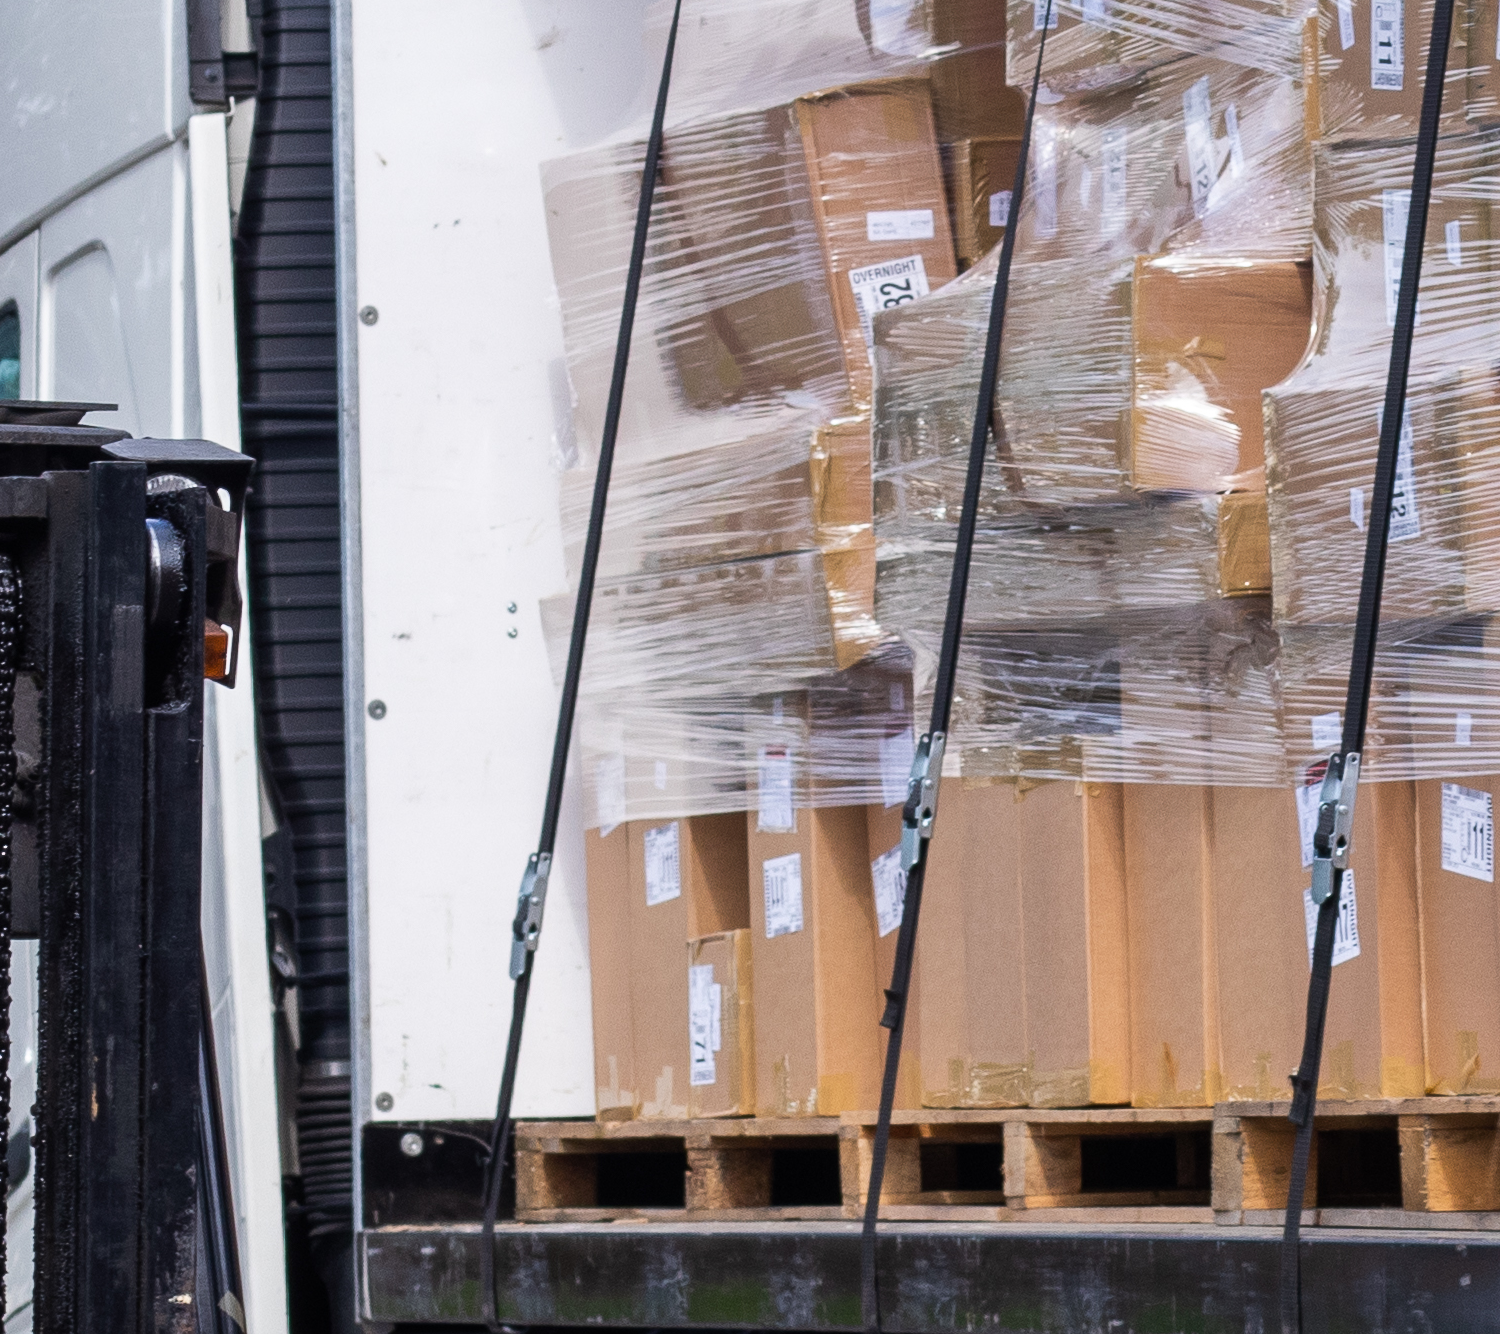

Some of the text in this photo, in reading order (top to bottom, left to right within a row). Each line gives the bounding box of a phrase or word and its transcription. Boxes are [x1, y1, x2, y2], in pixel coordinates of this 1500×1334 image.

[1378, 33, 1393, 65] 11
[852, 259, 917, 285] OVERNIGHT
[1472, 821, 1485, 862] 11
